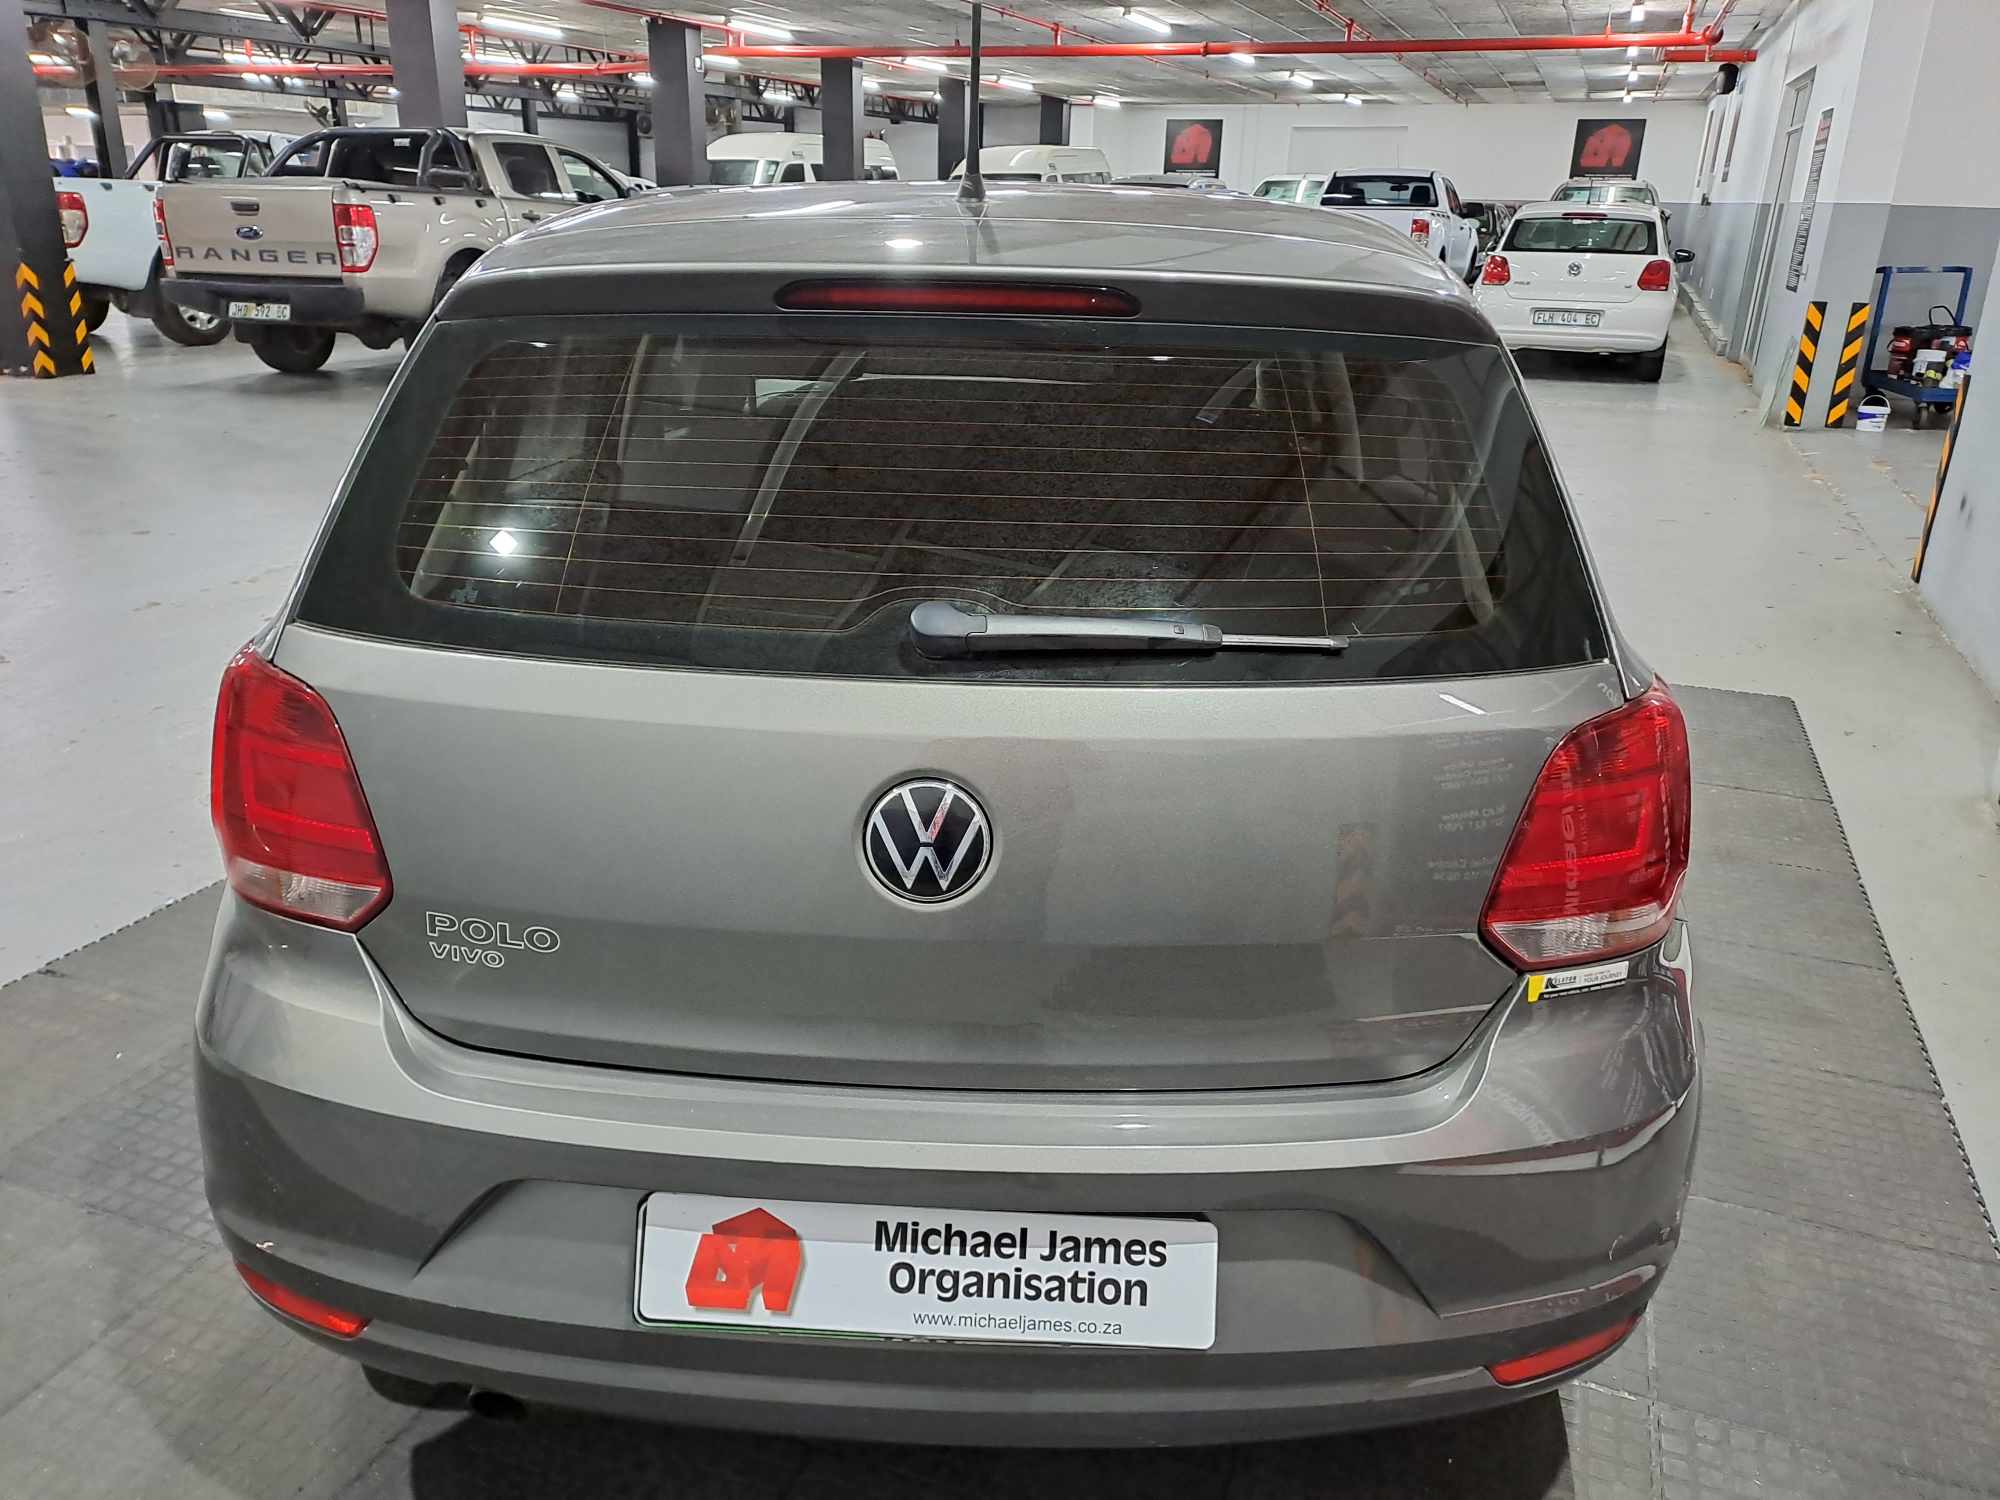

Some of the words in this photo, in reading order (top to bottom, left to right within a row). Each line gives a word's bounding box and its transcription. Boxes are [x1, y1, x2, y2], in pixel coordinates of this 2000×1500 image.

[175, 246, 337, 265] RANGER
[1560, 312, 1577, 323] 404
[1585, 313, 1598, 325] EC
[426, 911, 561, 953] POLO
[428, 941, 505, 968] VIVO
[874, 1220, 1029, 1260] Michael
[1039, 1230, 1168, 1268] James
[889, 1261, 1148, 1307] Organisation
[912, 1311, 1123, 1336] www.michaeljames.co.za
